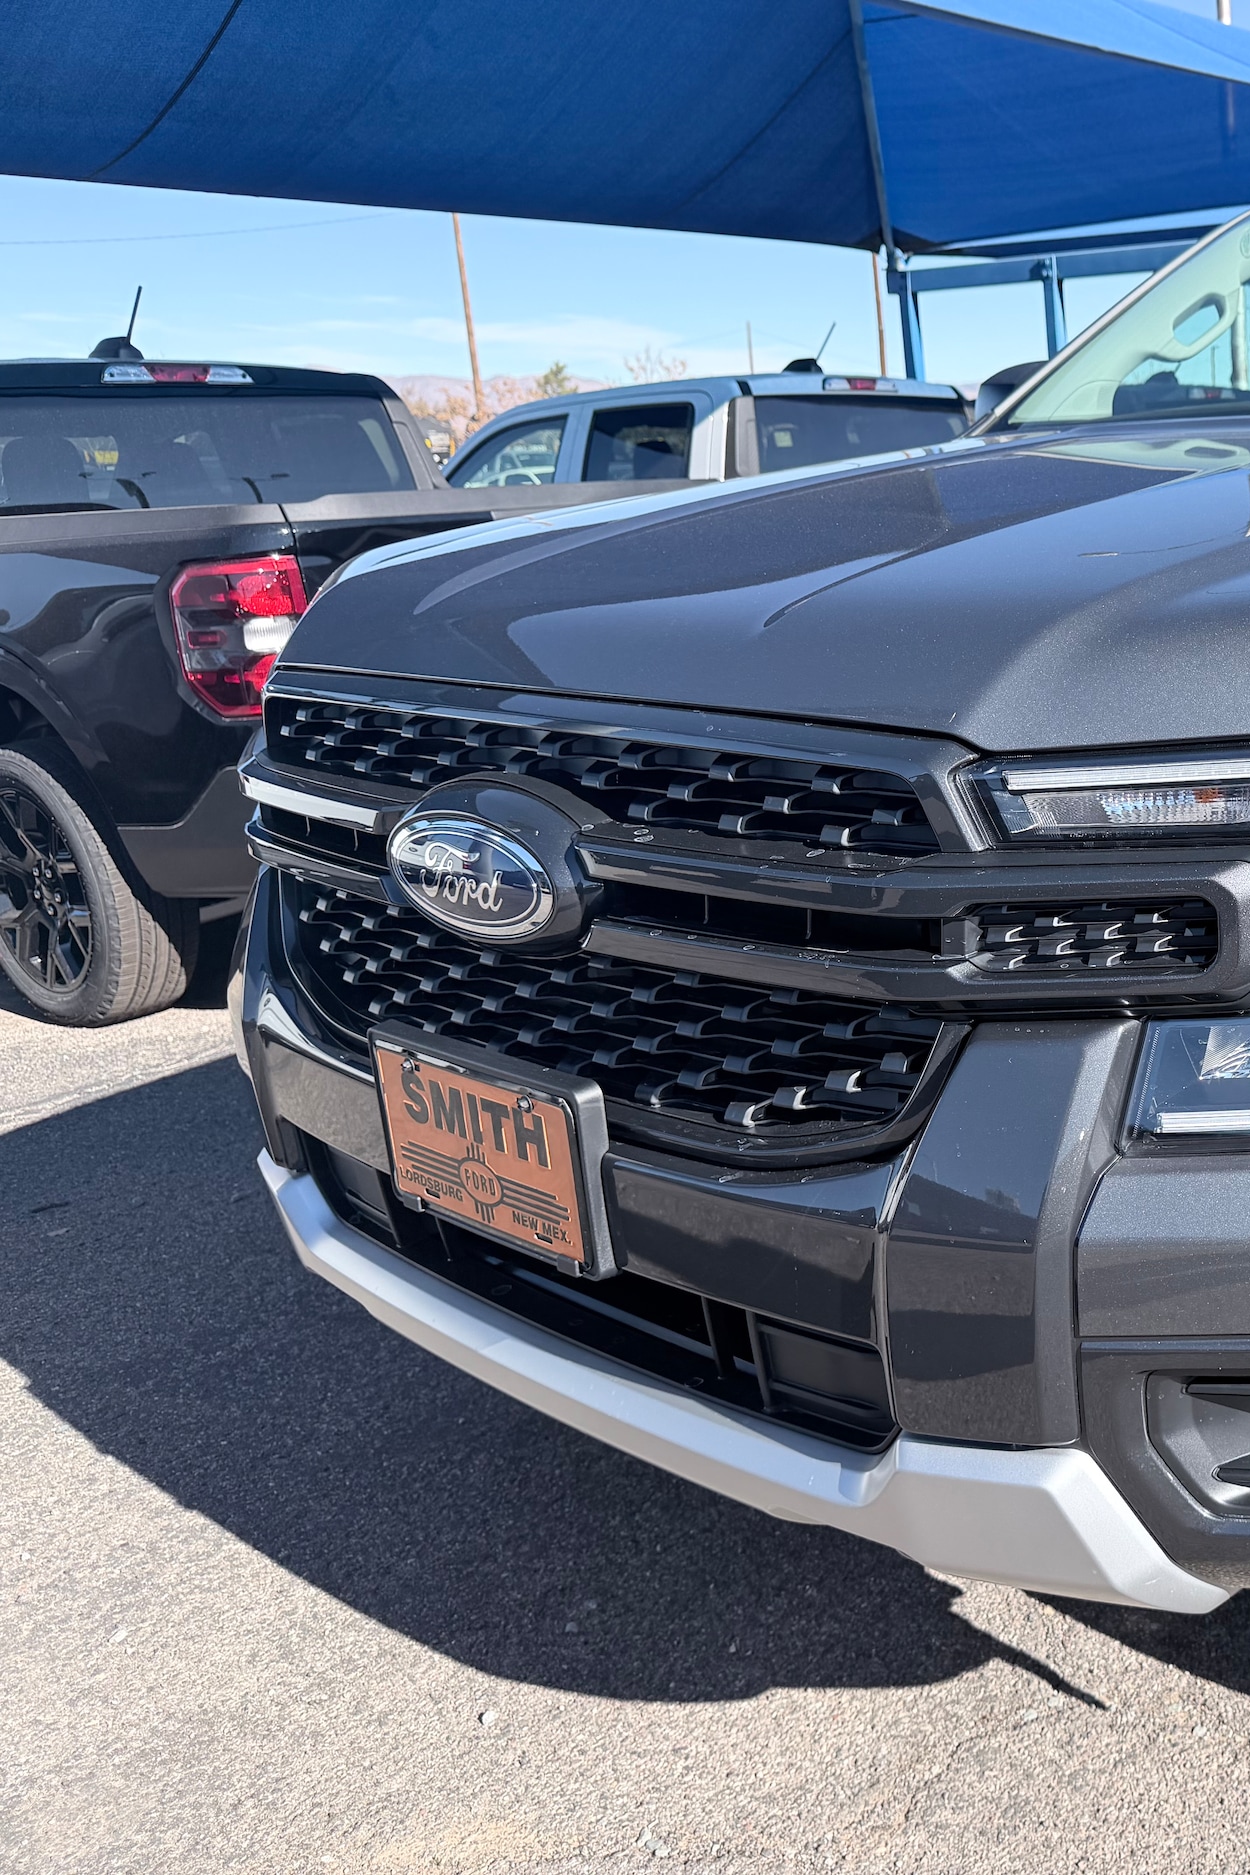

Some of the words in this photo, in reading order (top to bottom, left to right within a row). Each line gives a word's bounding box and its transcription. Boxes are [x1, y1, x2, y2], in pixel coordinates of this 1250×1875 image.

[420, 841, 503, 912] Ford
[401, 1072, 551, 1170] SMITH
[400, 1166, 463, 1202] LORDSBURG
[464, 1168, 496, 1197] FORD
[512, 1211, 538, 1232] NEW
